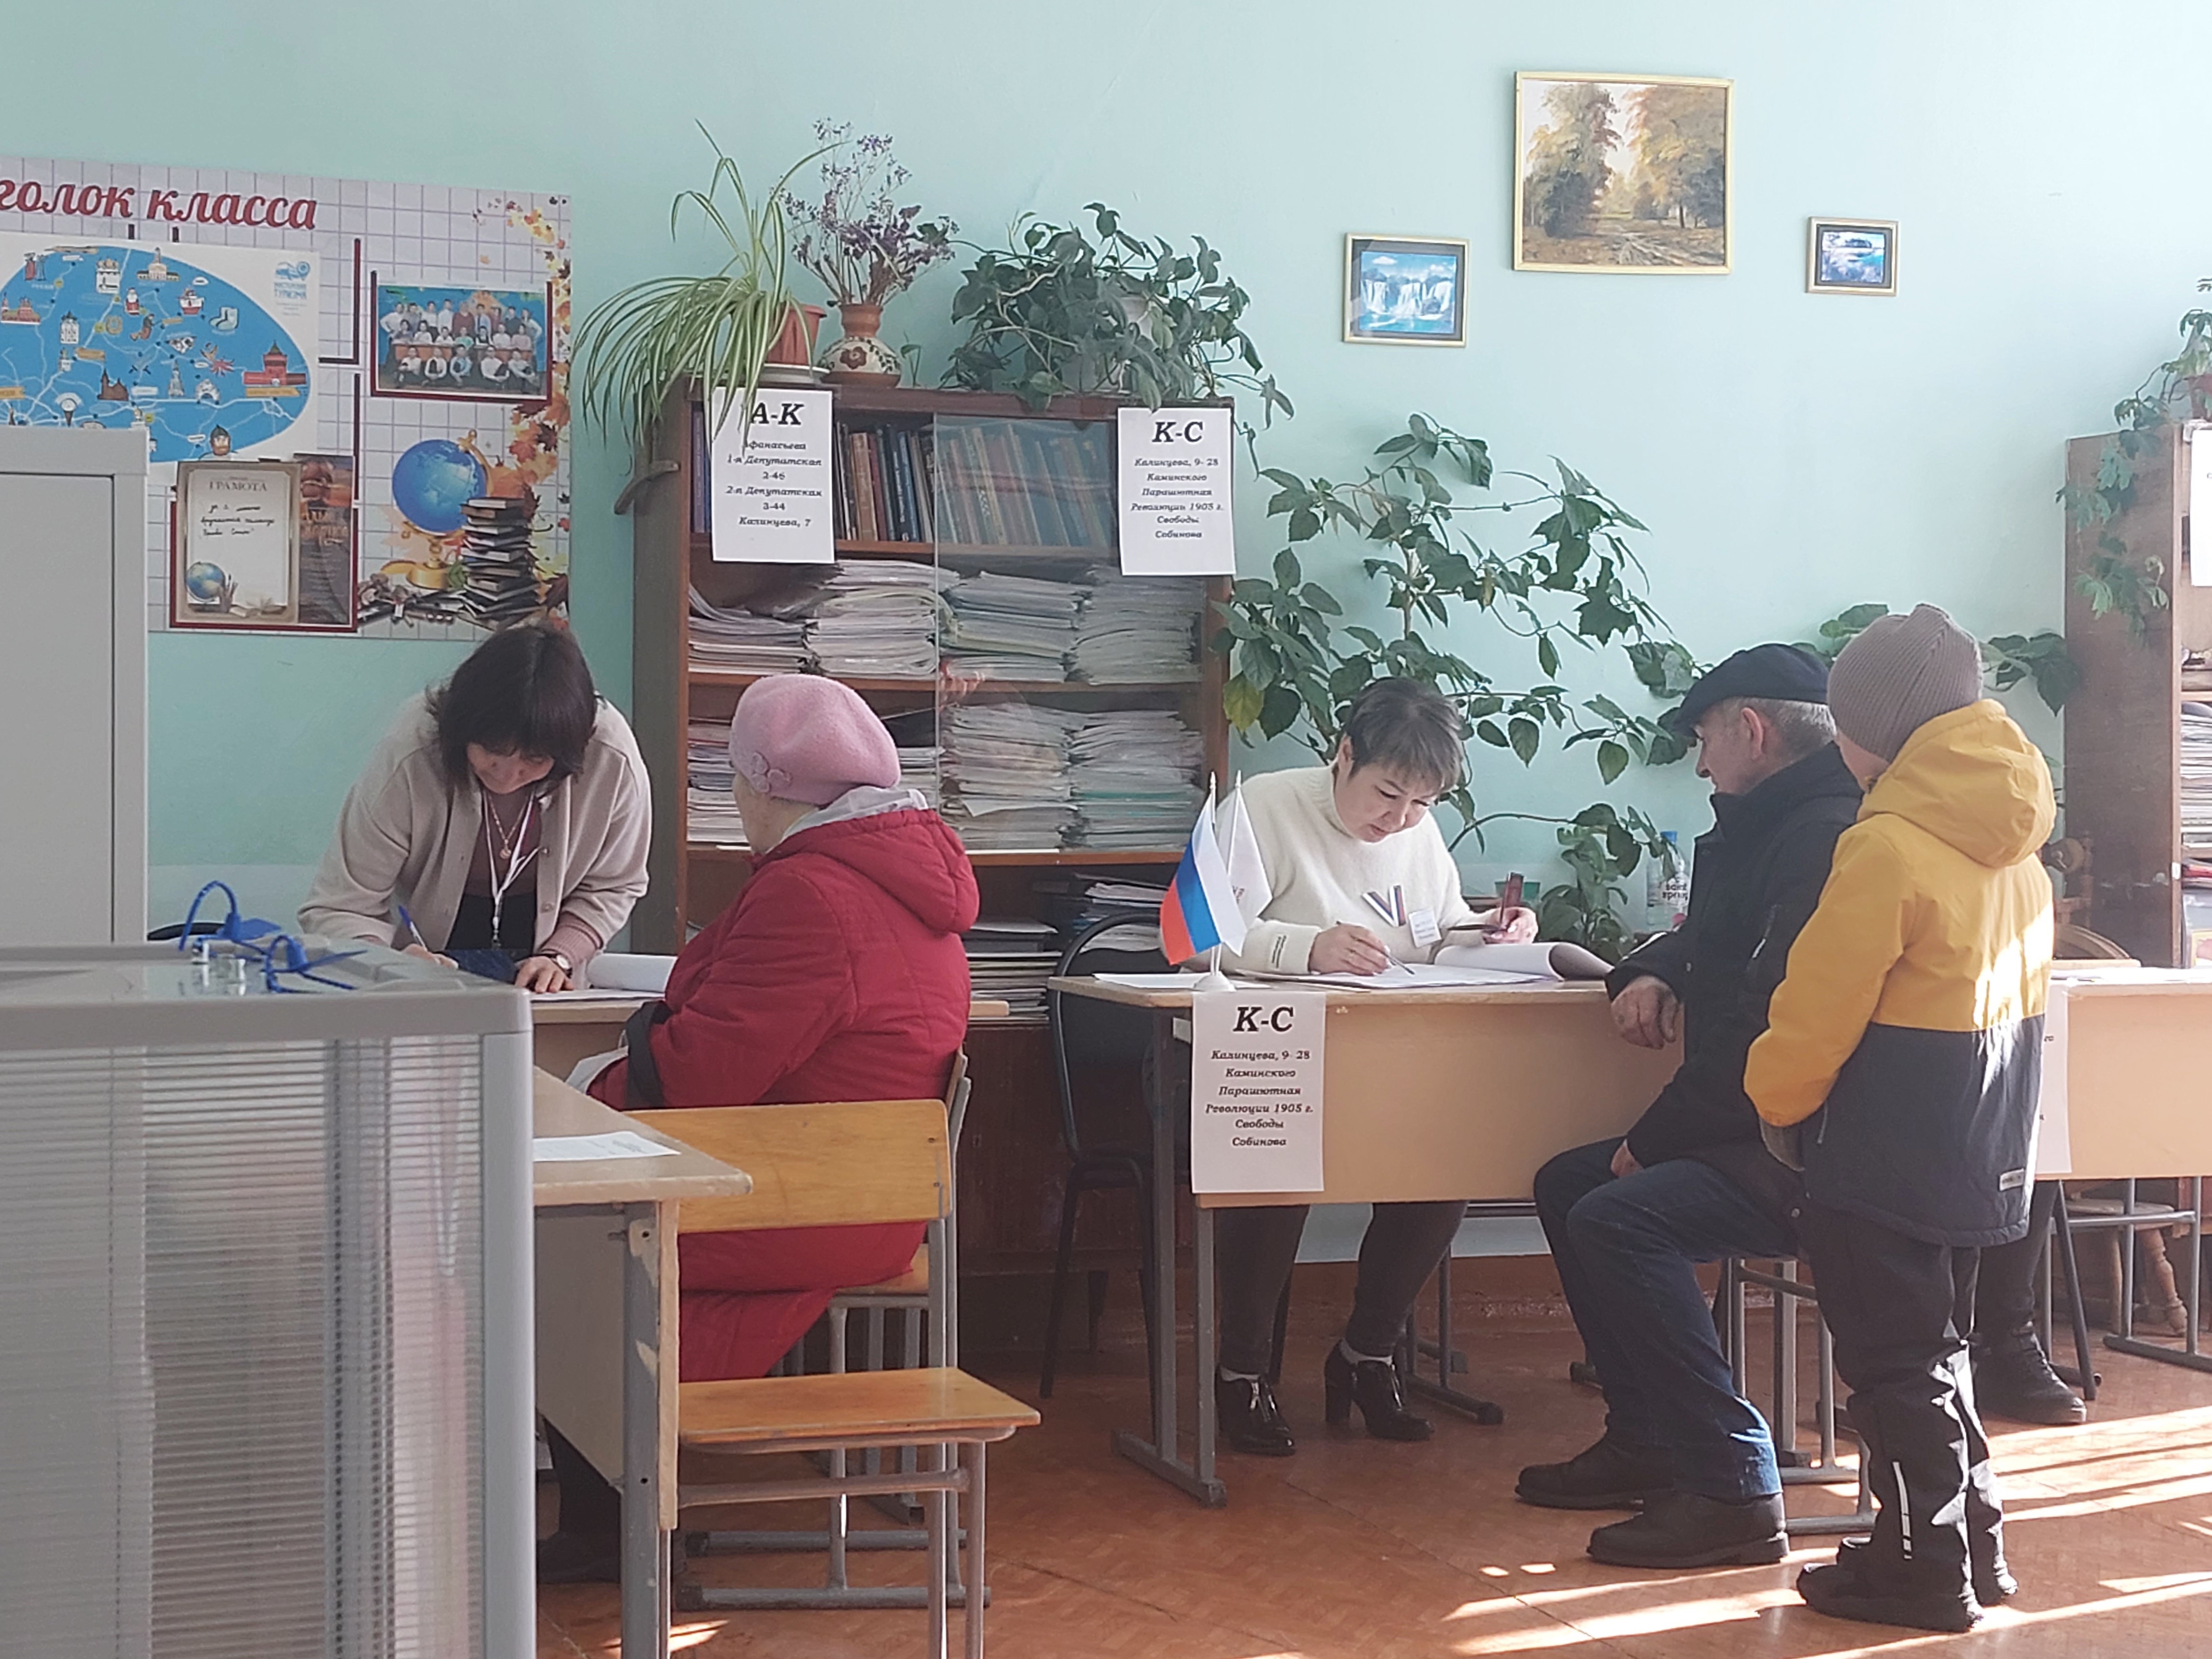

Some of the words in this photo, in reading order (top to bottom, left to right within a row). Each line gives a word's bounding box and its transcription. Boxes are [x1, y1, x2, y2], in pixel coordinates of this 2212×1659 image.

[147, 189, 317, 230] класса
[750, 402, 804, 425] А-К
[1152, 422, 1203, 442] К-С
[746, 441, 806, 450] фанасьева
[744, 456, 822, 466] Депутатская
[209, 481, 267, 491] ГРАМОТА
[745, 486, 822, 497] Депутатская
[1142, 488, 1212, 497] Парашютная
[1130, 503, 1186, 512] Революции
[1232, 1006, 1294, 1032] К-С
[1225, 1068, 1296, 1077] Каминского
[1219, 1086, 1301, 1097] Парашютная
[1205, 1104, 1269, 1115] Революции
[1274, 1104, 1302, 1113] 1905
[1235, 1119, 1284, 1128] Свободы
[1232, 1137, 1286, 1146] Собинова
